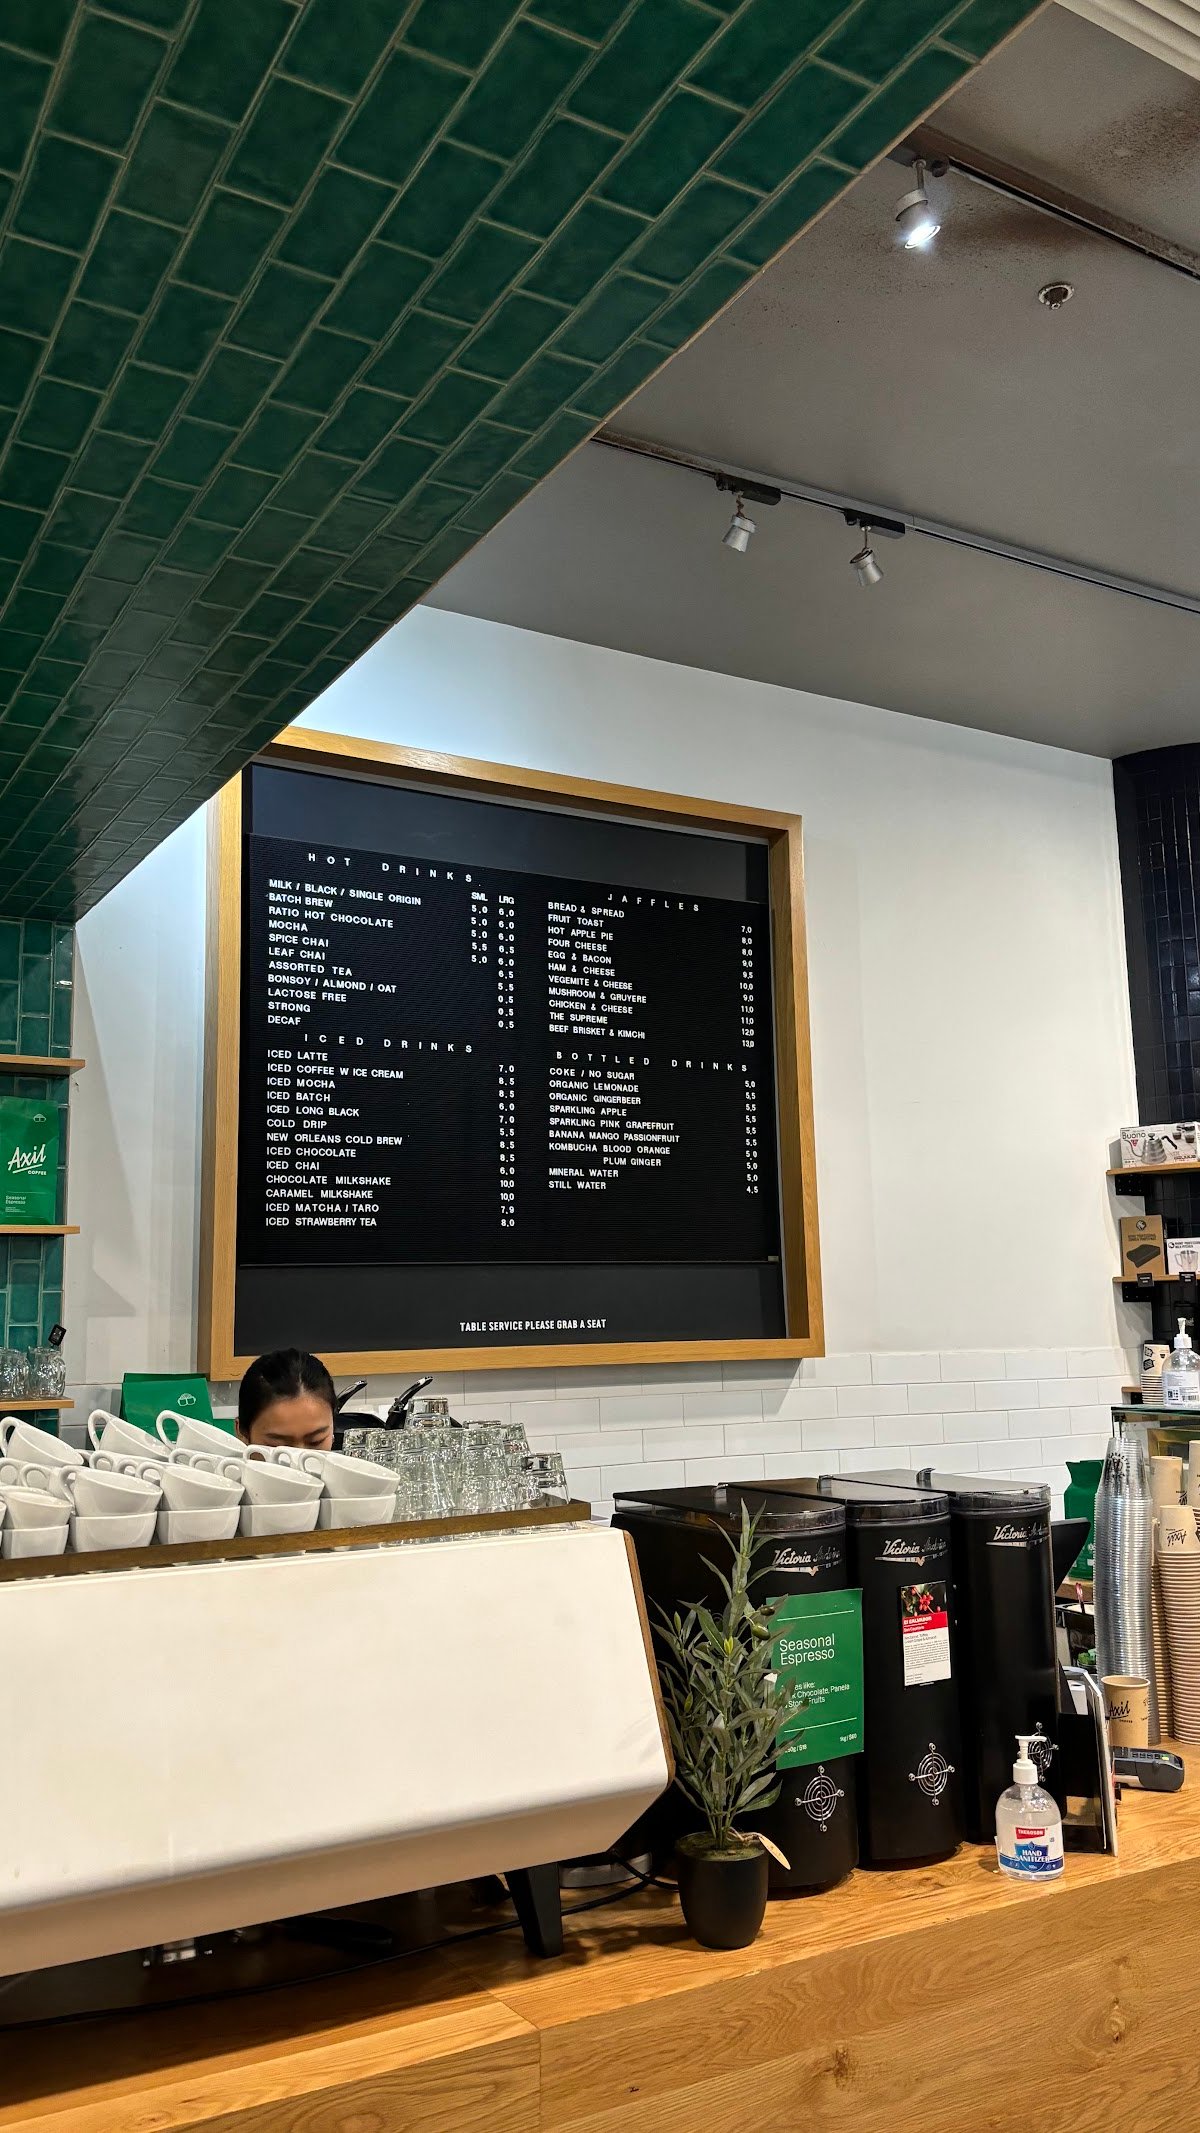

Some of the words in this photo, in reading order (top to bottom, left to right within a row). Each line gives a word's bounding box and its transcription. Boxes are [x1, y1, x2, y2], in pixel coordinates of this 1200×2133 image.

[308, 853, 350, 866] HOT
[382, 863, 472, 882] DRINKS
[269, 879, 292, 890] MILK
[305, 883, 337, 895] BLACK
[349, 889, 383, 901] SINGLE
[388, 894, 421, 905] ORIGIN
[471, 892, 488, 901] SML
[499, 895, 514, 904] LRG
[269, 892, 301, 904] BATCH
[305, 897, 333, 908] BREW
[608, 894, 699, 911] JAFFLES
[471, 904, 488, 914] 5.0
[499, 908, 514, 917] 6.0
[548, 902, 577, 912] BREAD
[591, 907, 624, 918] SPREAD
[269, 906, 299, 917] RATIO
[304, 910, 325, 920] HOT
[330, 913, 393, 928] CHOCOLATE
[548, 914, 571, 923] FRUIT
[577, 917, 604, 927] TOAST
[269, 919, 308, 932] MOCHA
[548, 926, 565, 935] HOT
[571, 929, 596, 938] APPLE
[601, 932, 613, 940] PIE
[269, 933, 298, 944] SPICE
[302, 937, 329, 947] CHAI
[548, 938, 570, 947] FOUR
[575, 941, 607, 952] CHEESE
[269, 947, 295, 957] LEAF
[300, 950, 325, 960] CHAI
[548, 950, 565, 959] EGG
[583, 954, 611, 964] BACON
[269, 961, 325, 973] ASSORTED
[332, 966, 352, 976] TEA
[548, 963, 566, 971] HAM
[583, 966, 615, 976] CHEESE
[268, 974, 311, 985] BONSOY
[323, 979, 366, 990] ALMOND
[377, 984, 397, 993] OAT
[548, 975, 589, 986] VEGEMITE
[594, 979, 599, 987] &
[603, 980, 632, 990] CHEESE
[268, 988, 316, 1000] LACTOSE
[322, 992, 347, 1002] FREE
[549, 987, 596, 999] MUSHROOM
[610, 993, 646, 1003] GRUYERE
[268, 1001, 310, 1012] STRONG
[549, 999, 586, 1010] CHICKEN
[591, 1003, 596, 1011] &
[601, 1004, 633, 1014] CHEESE
[268, 1015, 301, 1025] DECAF
[549, 1012, 564, 1020] THE
[570, 1014, 608, 1024] SUPREME
[549, 1024, 569, 1033] BEEF
[573, 1026, 606, 1035] BRISKET
[618, 1030, 645, 1039] KIMCHI
[305, 1034, 364, 1045] ICED
[384, 1039, 472, 1053] DRINKS
[268, 1049, 292, 1059] ICED
[297, 1051, 328, 1061] LATTE
[556, 1051, 649, 1065] BOTTLED
[672, 1059, 747, 1072] DRINKS
[268, 1063, 291, 1072] ICED
[297, 1065, 334, 1075] COFFEE
[340, 1067, 349, 1075] W
[353, 1068, 367, 1077] ICE
[371, 1069, 403, 1079] CREAM
[499, 1065, 514, 1073] 7.0
[549, 1068, 575, 1076] COKE
[589, 1070, 601, 1078] NO
[607, 1071, 634, 1080] SUGAR
[267, 1077, 291, 1086] ICED
[297, 1078, 335, 1089] MOCHA
[549, 1080, 589, 1089] ORGANIC
[593, 1082, 639, 1092] LEMONADE
[267, 1091, 290, 1100] ICED
[296, 1092, 330, 1102] BATCH
[549, 1092, 587, 1102] ORGANIC
[593, 1095, 641, 1105] GINGERBEER
[267, 1105, 290, 1114] ICED
[296, 1106, 323, 1115] LONG
[329, 1107, 359, 1117] BLACK
[549, 1105, 595, 1114] SPARKLING
[600, 1108, 627, 1116] APPLE
[267, 1119, 295, 1128] COLD
[303, 1120, 327, 1129] DRIP
[549, 1117, 595, 1127] SPARKLING
[600, 1120, 620, 1128] PINK
[626, 1121, 674, 1130] GRAPEFRUIT
[267, 1133, 288, 1141] NEW
[294, 1134, 341, 1143] ORLEANS
[345, 1135, 373, 1144] COLD
[377, 1136, 402, 1145] BREW
[549, 1130, 585, 1139] BANANA
[589, 1132, 619, 1140] MANGO
[624, 1133, 680, 1142] PASSIONFRUIT
[1122, 1132, 1146, 1140] Buono
[267, 1147, 291, 1155] ICED
[296, 1147, 356, 1157] CHOCOLATE
[549, 1142, 597, 1152] KOMBUCHA
[603, 1145, 631, 1153] BLOOD
[637, 1146, 670, 1154] ORANGE
[8, 1144, 47, 1171] Axil
[603, 1157, 626, 1165] PLUM
[630, 1158, 661, 1166] GINGER
[266, 1161, 289, 1169] ICED
[295, 1161, 319, 1170] CHAI
[549, 1168, 584, 1176] MINERAL
[589, 1169, 618, 1177] WATER
[266, 1175, 327, 1184] CHOCOLATE
[336, 1176, 391, 1185] MILKSHAKE
[548, 1181, 572, 1189] STILL
[577, 1181, 606, 1189] WATER
[266, 1189, 314, 1198] CARAMEL
[321, 1190, 373, 1198] MILKSHAKE
[266, 1203, 290, 1212] ICED
[295, 1203, 341, 1212] MATCHA
[352, 1204, 379, 1212] TARO
[266, 1217, 289, 1226] ICED
[295, 1217, 357, 1226] STRAWBERRY
[360, 1218, 377, 1226] TEA
[460, 1322, 486, 1332] TABLE
[489, 1321, 523, 1331] SERVICE
[525, 1320, 554, 1330] PLEASE
[557, 1320, 578, 1329] GRAB
[580, 1320, 585, 1328] A
[587, 1319, 606, 1328] SEAT
[993, 1524, 1028, 1540] Victoria
[882, 1538, 920, 1556] Victoria
[773, 1547, 811, 1565] Victoria
[779, 1632, 835, 1652] Seasonal
[780, 1648, 835, 1666] Espresso
[830, 1683, 850, 1693] Panela
